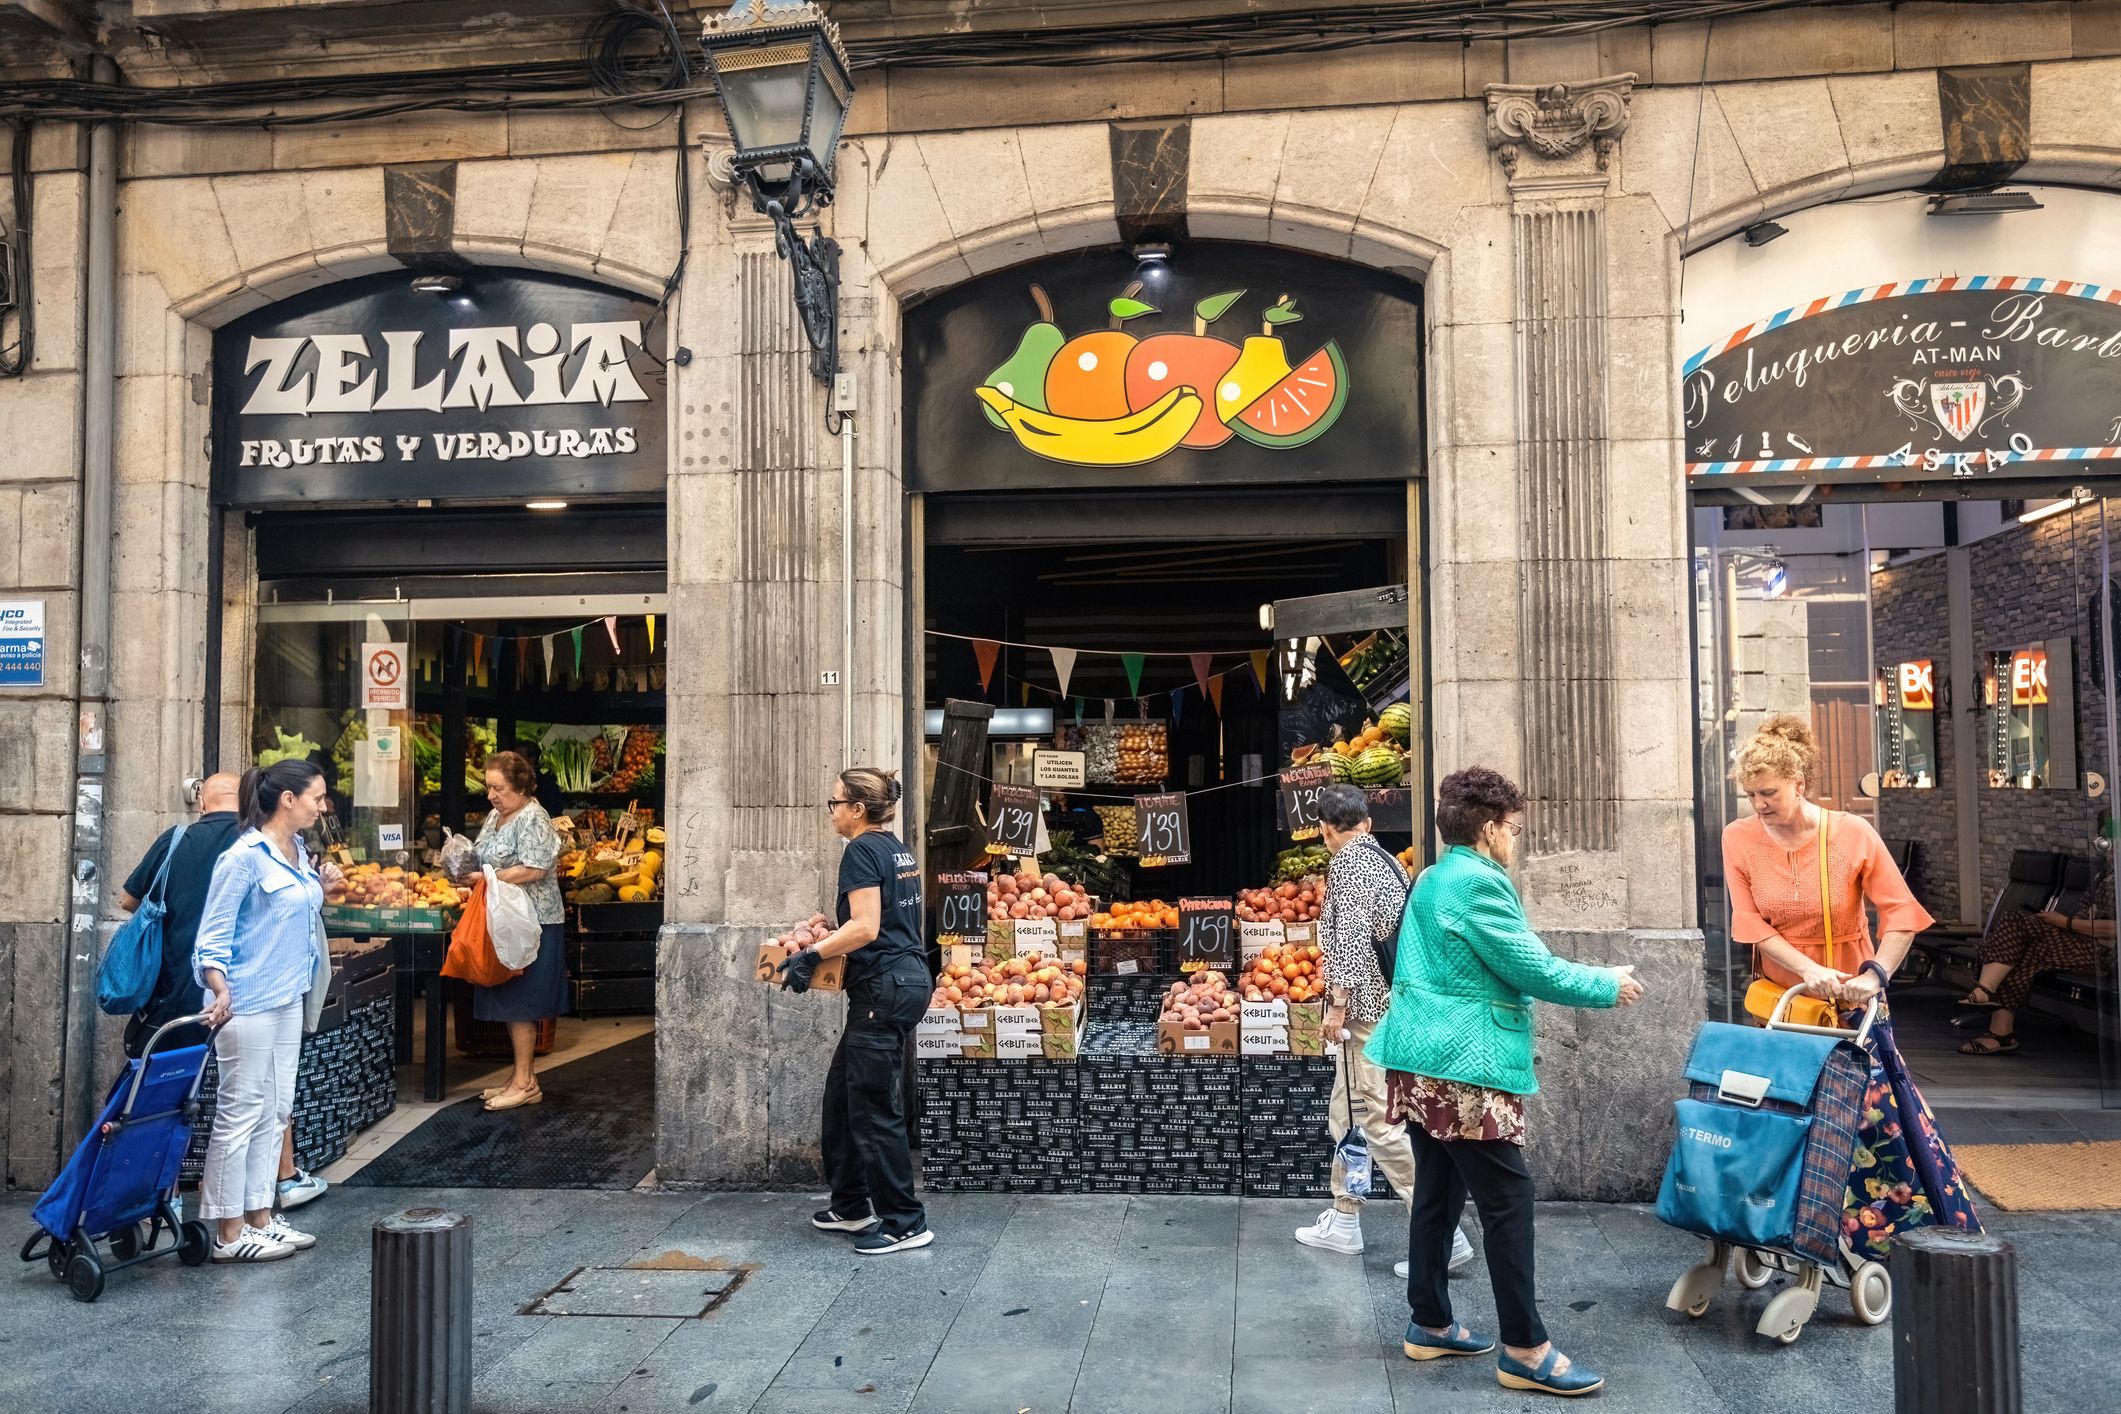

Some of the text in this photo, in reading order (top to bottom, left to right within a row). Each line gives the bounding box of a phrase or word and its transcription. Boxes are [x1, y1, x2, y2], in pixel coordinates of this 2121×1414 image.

[1911, 345, 2002, 365] AT-MAN
[241, 426, 638, 469] FRUTAS Y VERDURAS
[1888, 432, 2034, 477] ASKAO
[5, 662, 22, 671] 444
[23, 662, 42, 671] 440
[822, 671, 838, 684] 11
[382, 833, 401, 842] VISA
[1560, 865, 1580, 874] ALEX
[1016, 926, 1043, 936] GEBUT
[1242, 928, 1269, 937] GEBUT
[1242, 1009, 1272, 1018] GEBUT
[996, 1015, 1025, 1024] GEBUT
[918, 1039, 945, 1048] GEBUT
[998, 1039, 1025, 1048] GEBUT
[1242, 1036, 1272, 1045] GEBUT
[1688, 1127, 1732, 1149] TERMO
